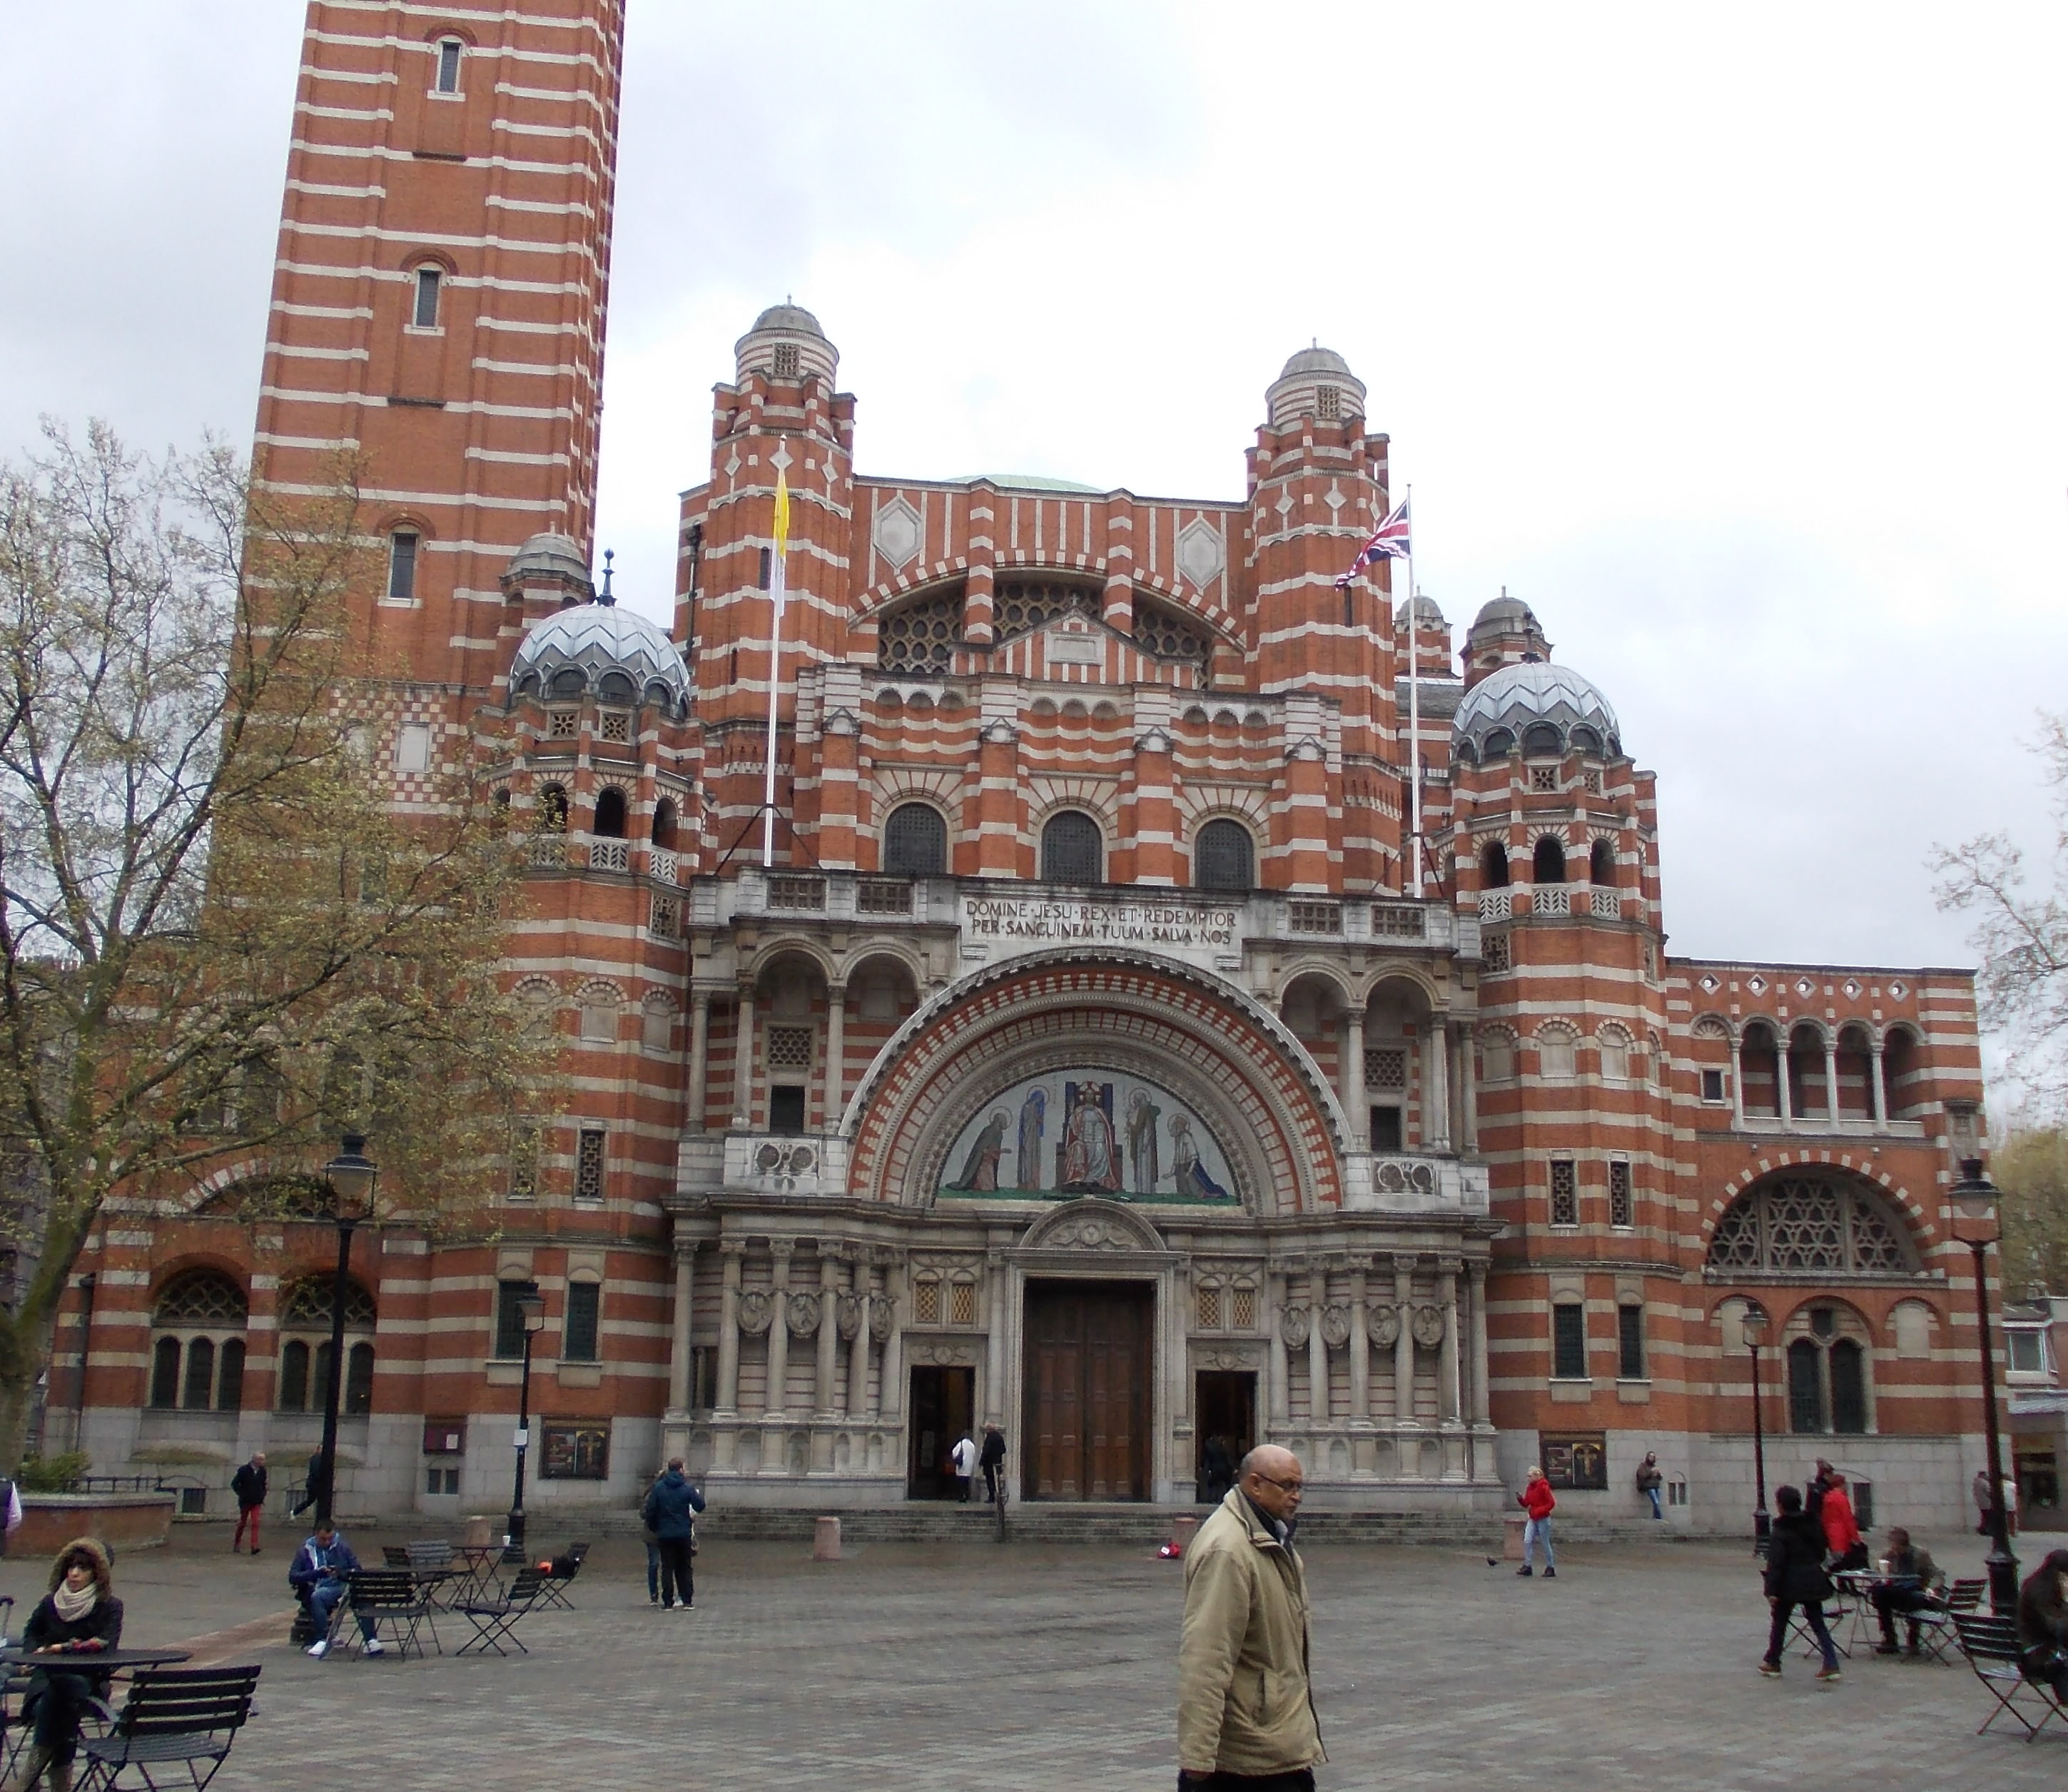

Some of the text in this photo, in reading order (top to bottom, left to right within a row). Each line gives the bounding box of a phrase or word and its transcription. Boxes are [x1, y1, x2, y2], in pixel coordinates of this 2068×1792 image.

[966, 901, 1236, 926] DOMINE JESU REX ET REDEMPTOR
[973, 918, 1232, 944] PER SANGUINEM TUUM SALVA NOS
